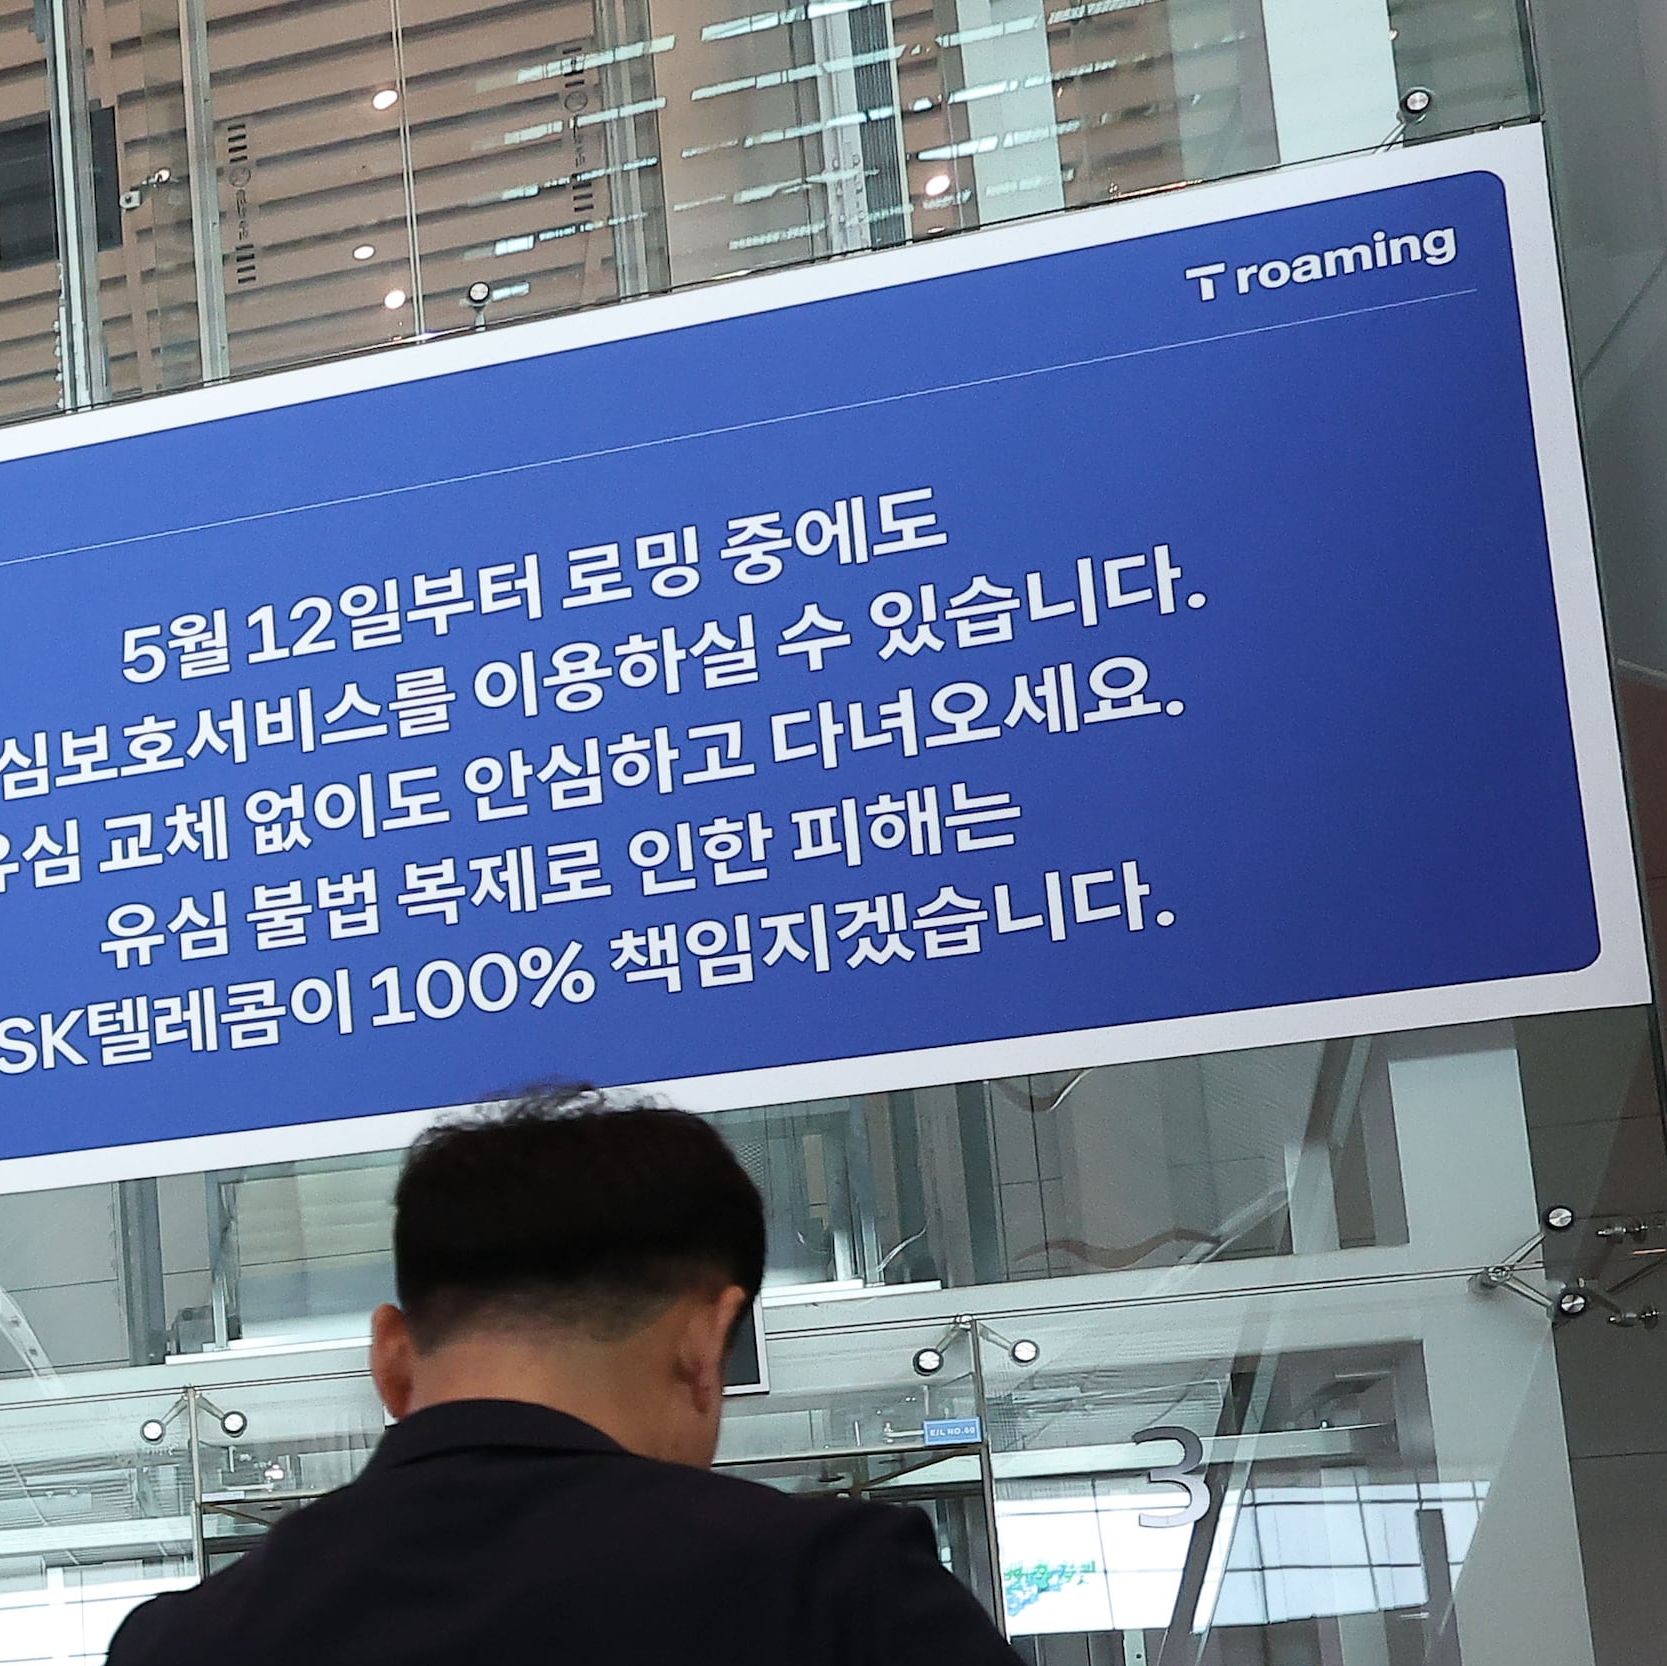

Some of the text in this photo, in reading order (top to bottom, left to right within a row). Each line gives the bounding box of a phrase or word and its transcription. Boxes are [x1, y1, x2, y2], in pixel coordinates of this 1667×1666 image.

[1185, 220, 1457, 302] T roaming
[122, 487, 947, 683] 5월 12일부터 로밍 중에도
[474, 614, 759, 717] 이용하실
[777, 603, 851, 671] 수
[870, 544, 1206, 660] 있습니다.
[99, 796, 229, 873] 교체
[245, 766, 450, 855] 없이도
[464, 721, 755, 822] 안심하고
[771, 656, 1184, 769] 다녀오세요.
[100, 782, 1022, 969] 유심 불법 복제로 인한 피해는
[370, 940, 596, 1028] 100%
[609, 860, 1175, 993] 책임지겠습니다.
[1132, 1425, 1211, 1528] 3
